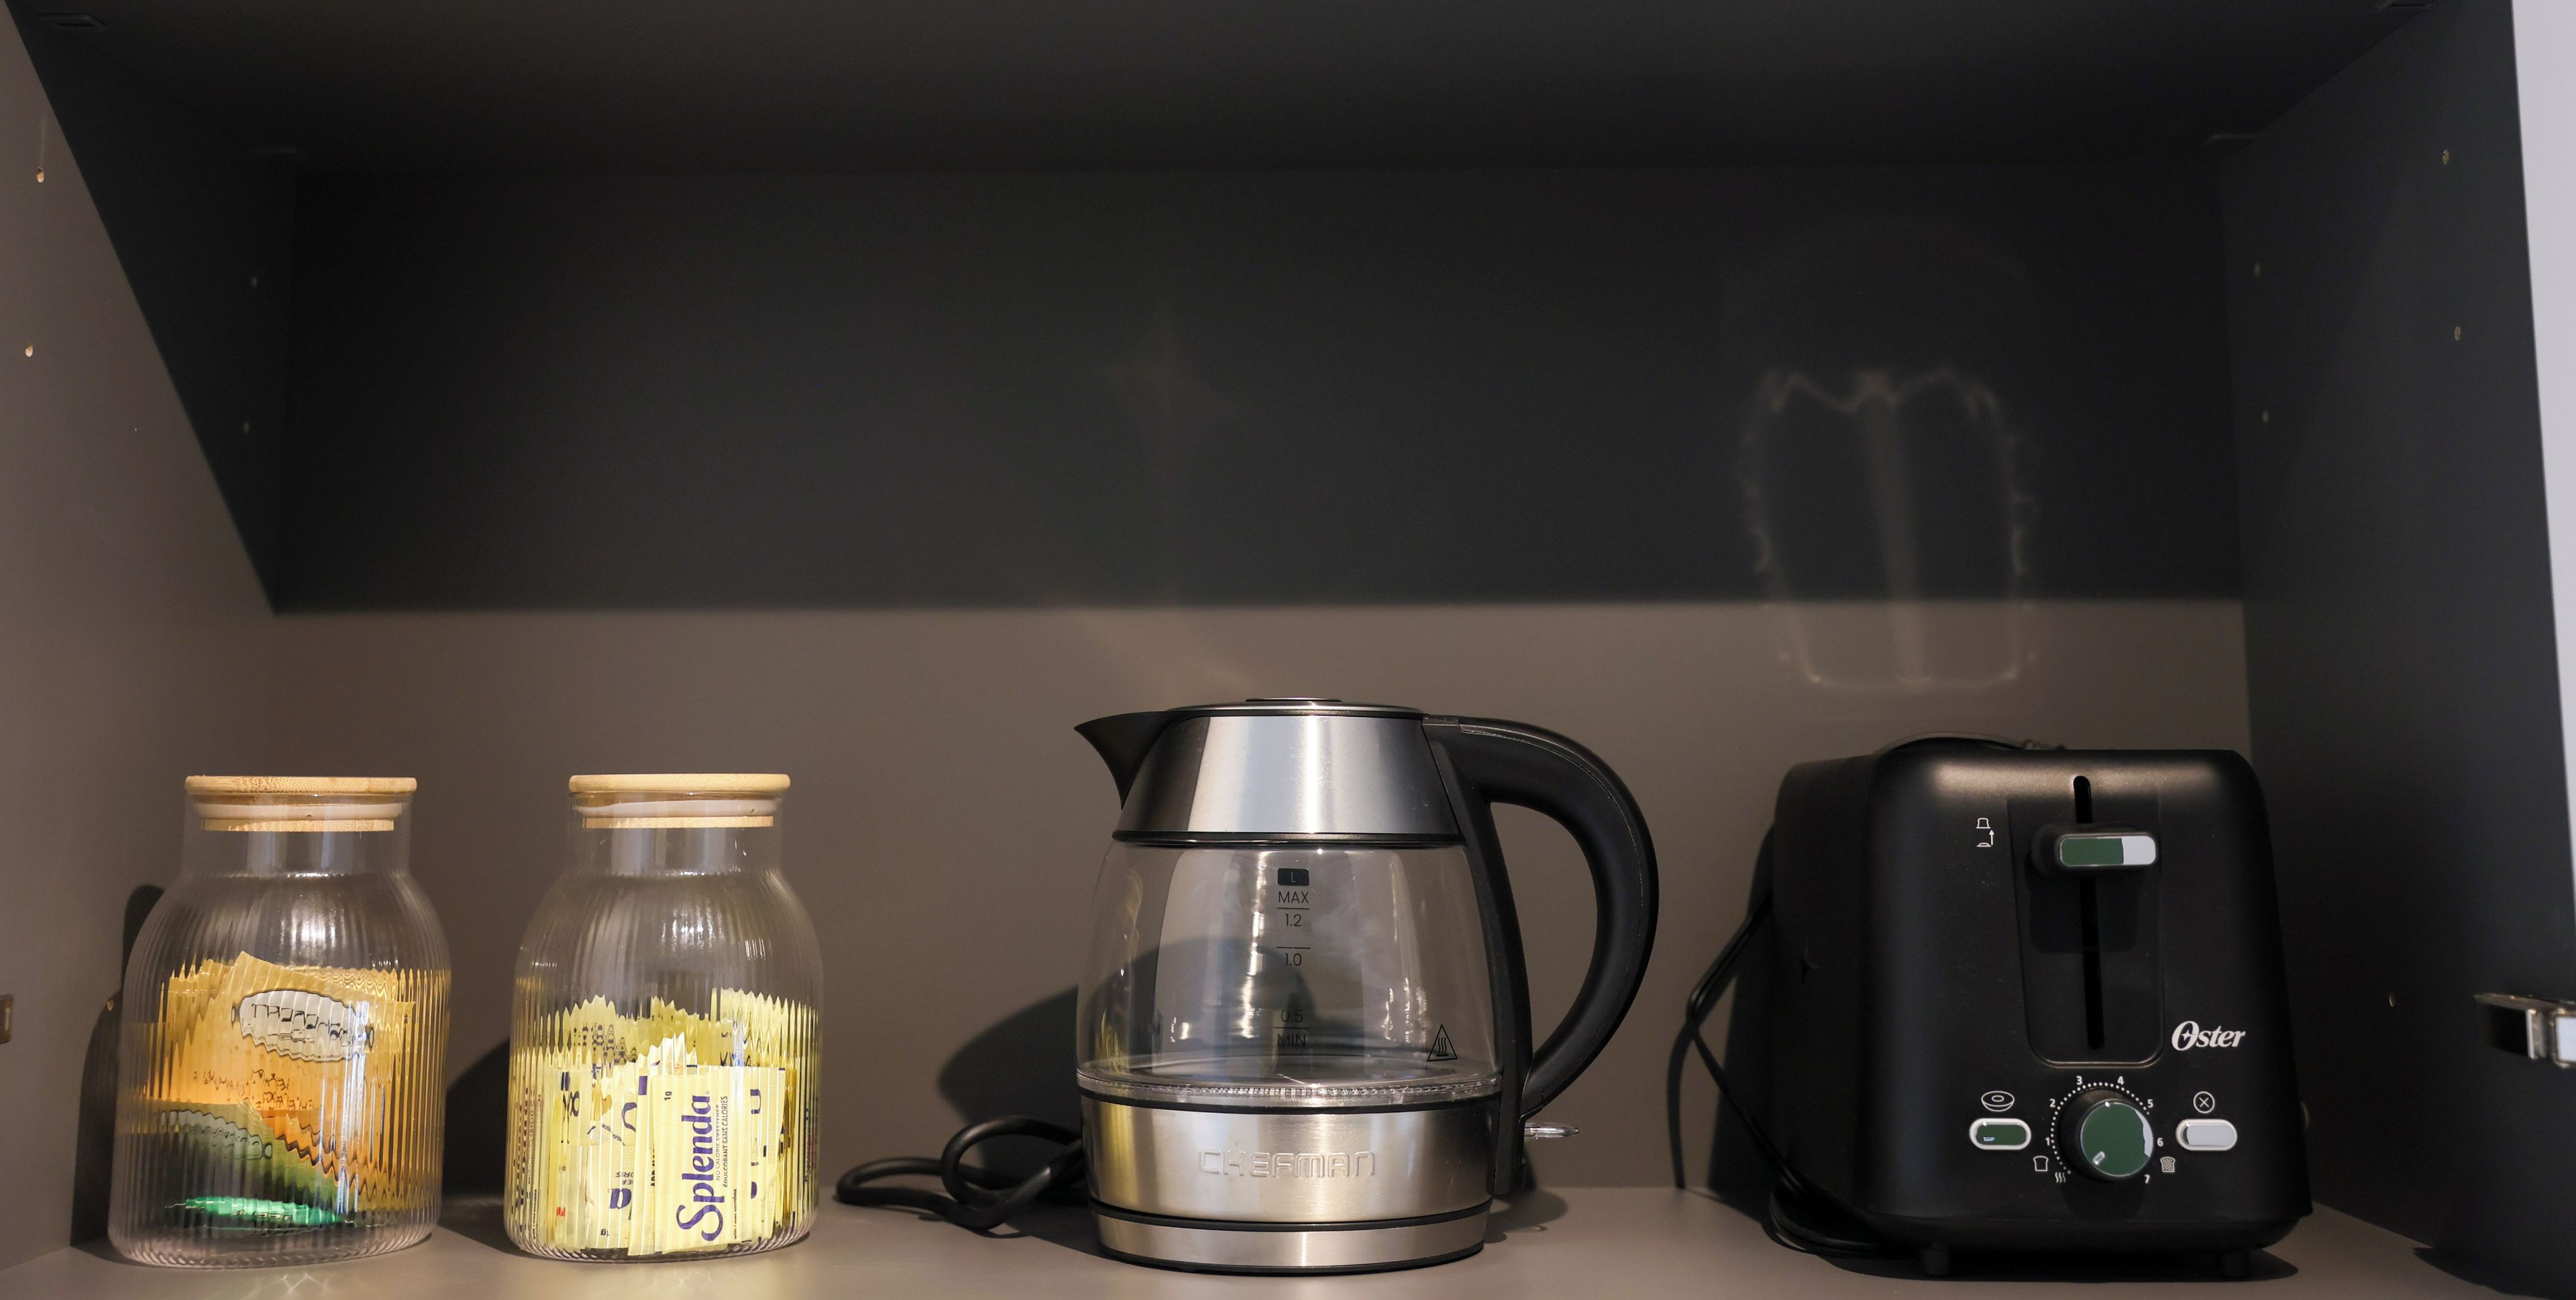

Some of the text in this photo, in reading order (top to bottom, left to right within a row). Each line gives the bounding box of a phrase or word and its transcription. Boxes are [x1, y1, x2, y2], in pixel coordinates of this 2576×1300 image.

[1291, 871, 1296, 883] L
[1278, 891, 1309, 904] MAX
[1285, 914, 1302, 927] 1.2
[1285, 953, 1302, 967] 1.0
[1281, 1009, 1303, 1023] 0.5
[1277, 1033, 1305, 1046] MIN
[2171, 1020, 2246, 1051] Oster
[2076, 1075, 2082, 1085] 3
[2117, 1076, 2124, 1085] 4
[663, 1091, 672, 1101] 1g
[2049, 1099, 2055, 1107] 2
[2147, 1099, 2153, 1108] 5
[720, 1095, 729, 1126] CALORIES
[2045, 1137, 2050, 1146] 1
[2157, 1138, 2163, 1146] 6
[676, 1095, 725, 1242] Splenda
[1199, 1149, 1375, 1178] CHEFMAN
[716, 1171, 720, 1181] NO
[2144, 1175, 2150, 1184] 7
